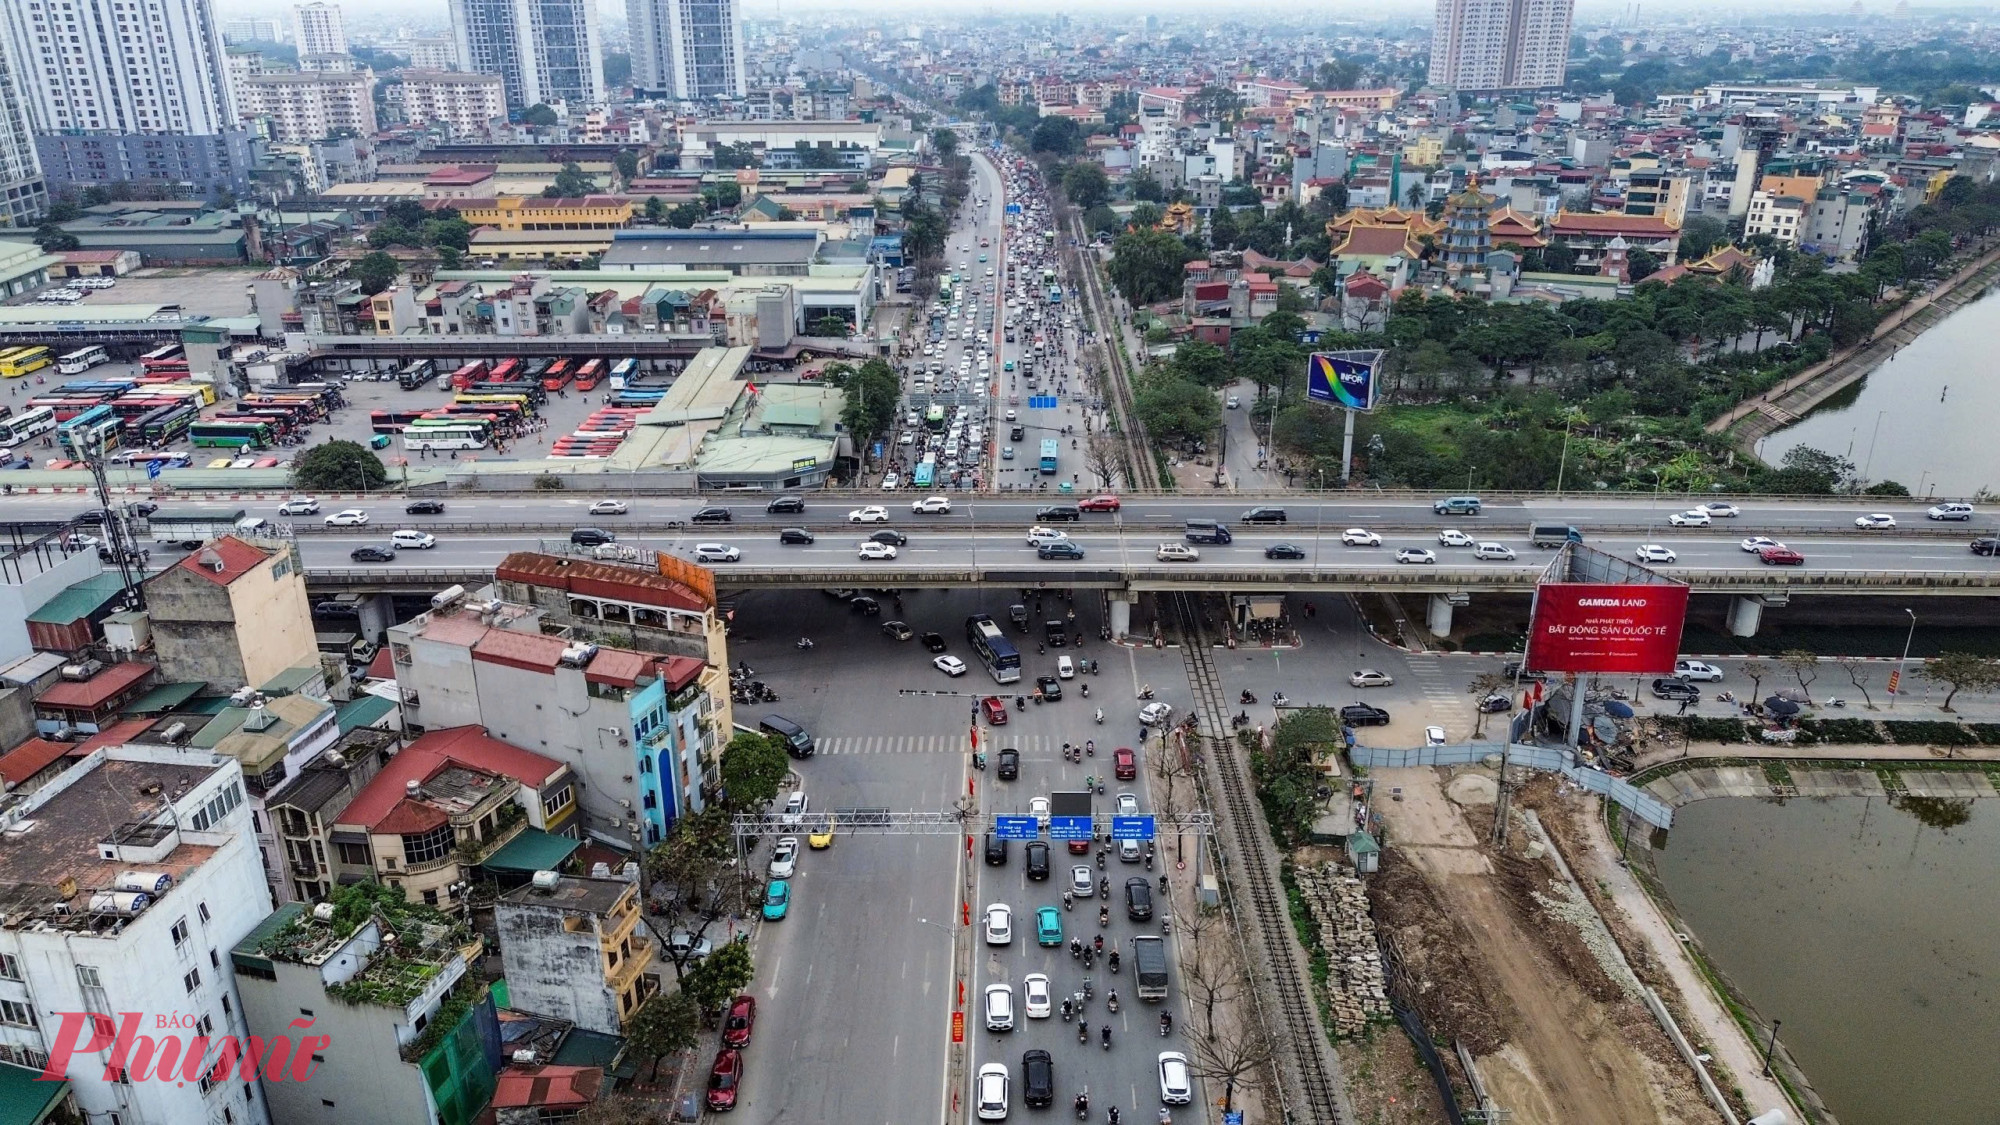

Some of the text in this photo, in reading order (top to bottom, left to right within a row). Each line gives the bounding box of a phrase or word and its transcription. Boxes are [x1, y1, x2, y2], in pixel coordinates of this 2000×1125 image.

[1578, 599, 1646, 607] GAMUDA LAND
[1548, 624, 1667, 635] BẤT ĐỘNG SẢN QUỐC TẾ
